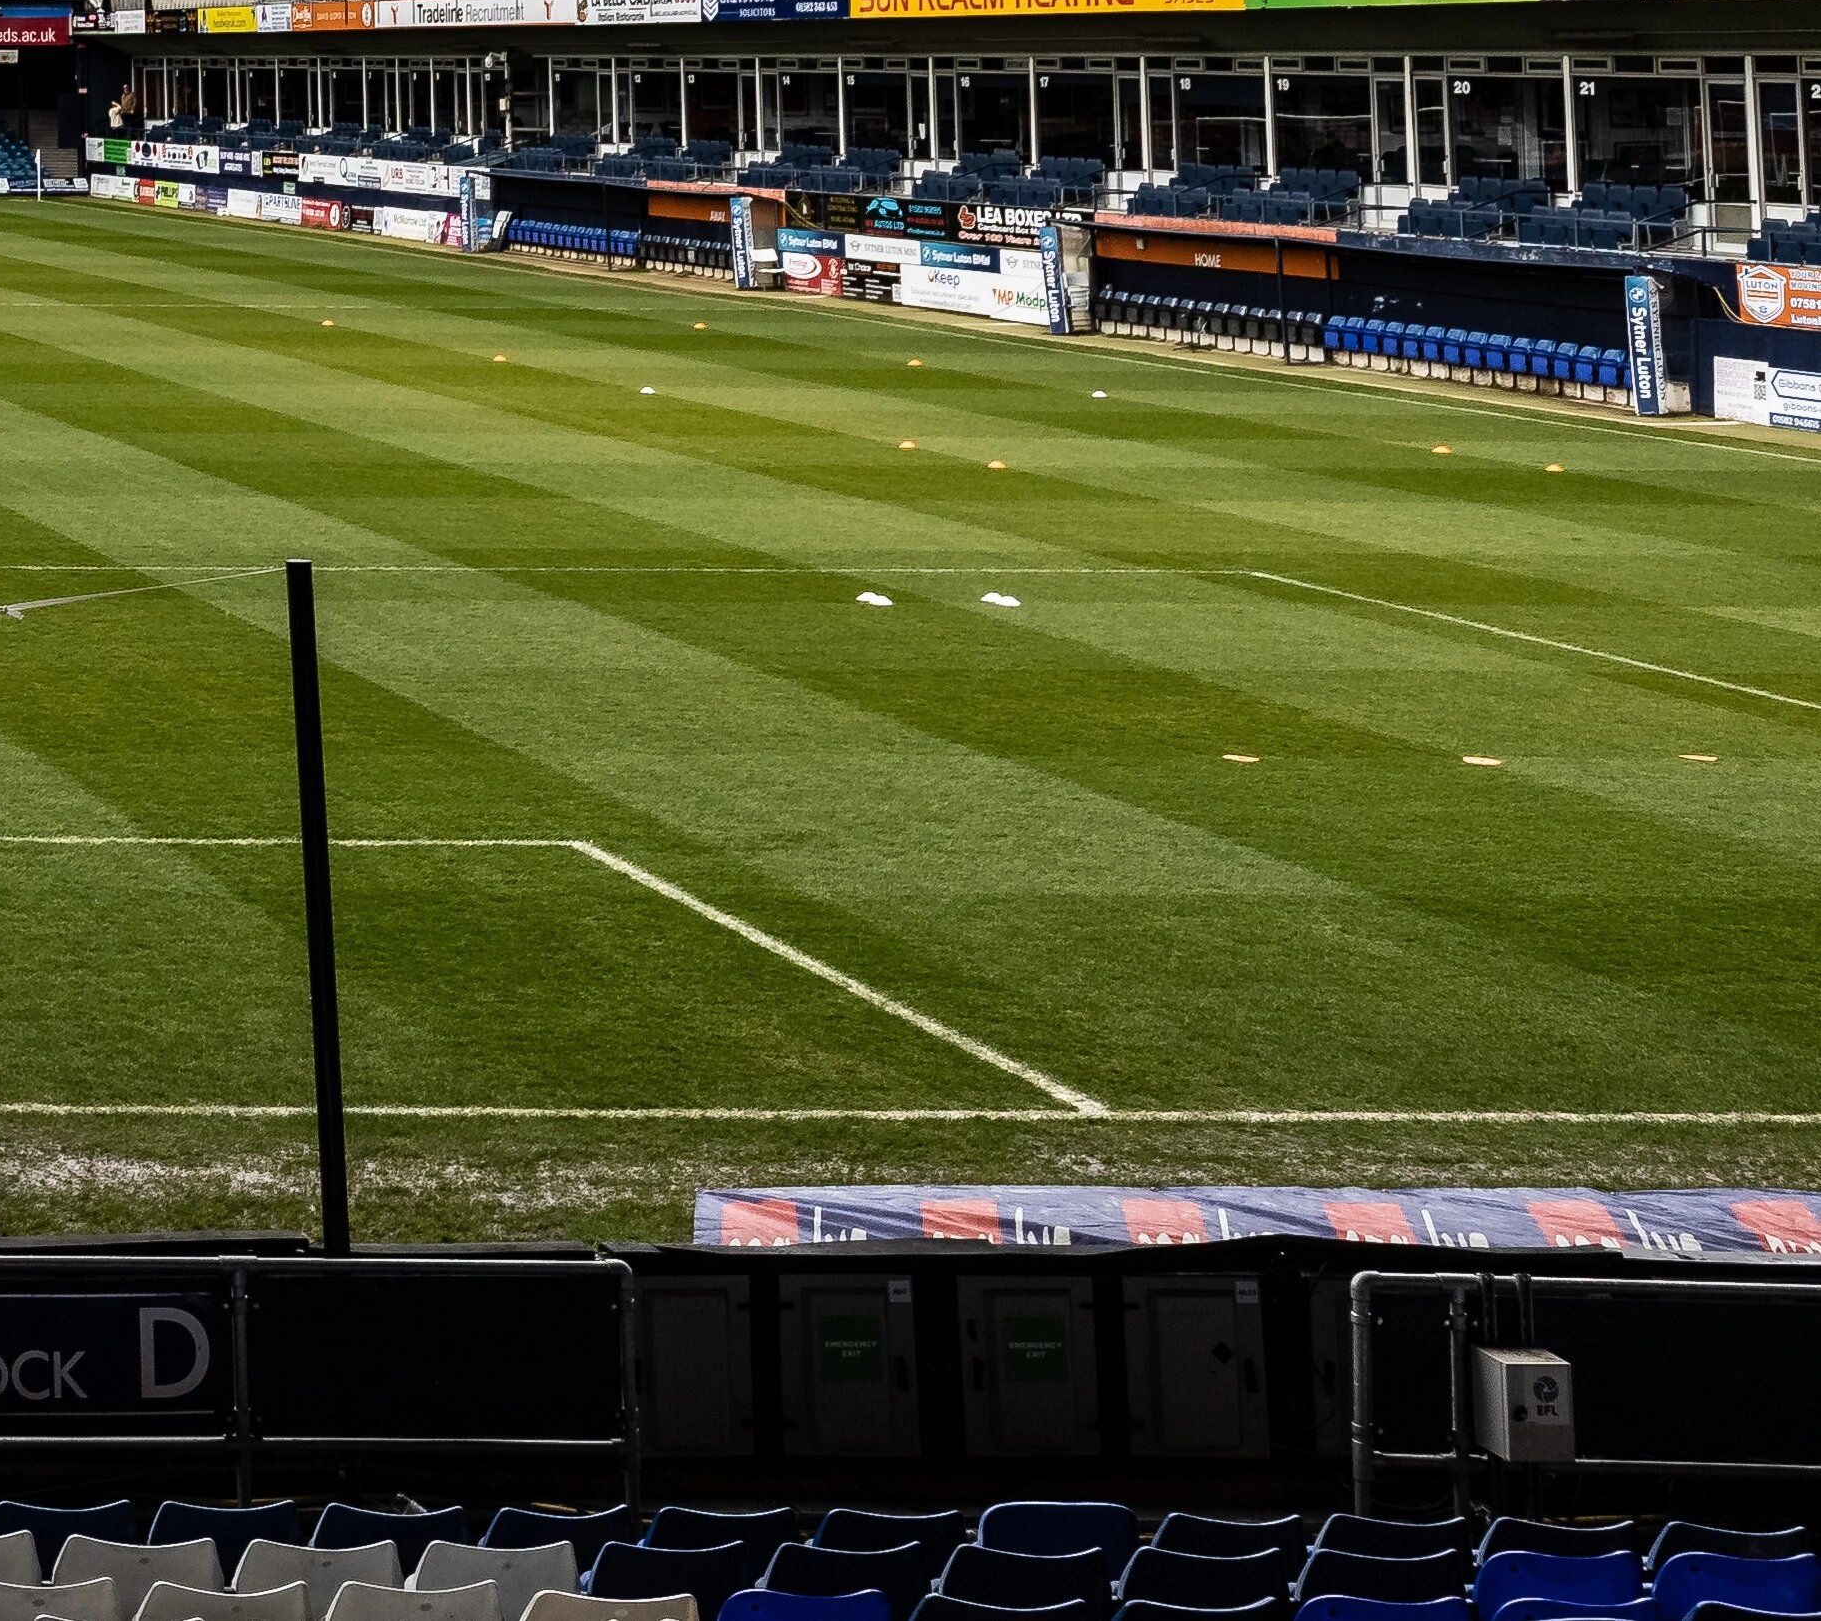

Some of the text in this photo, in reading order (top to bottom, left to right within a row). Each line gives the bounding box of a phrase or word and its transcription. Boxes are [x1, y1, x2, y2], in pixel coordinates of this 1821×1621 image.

[417, 1, 524, 24] Tradeline Recruitment
[739, 8, 775, 18] SOLICITORS
[1180, 79, 1191, 90] 18
[1277, 79, 1289, 90] 19
[1454, 81, 1471, 93] 20
[1580, 82, 1596, 95] 21
[977, 206, 1002, 224] LEA
[789, 235, 822, 248] Sytner Luton
[959, 231, 983, 241] Over
[732, 217, 746, 278] Sytner Luton
[932, 251, 972, 264] Sytner Luton
[1195, 253, 1221, 268] HOME
[1043, 251, 1060, 322] Sytner Luton
[1746, 280, 1778, 290] LUTON
[1630, 307, 1651, 398] Sytner Luton
[1779, 379, 1816, 392] Gibbons
[1773, 415, 1793, 426] 01582
[824, 1340, 878, 1349] EMERGENCY
[1009, 1341, 1062, 1350] EMERGENCY
[139, 1307, 210, 1399] D
[842, 1350, 861, 1358] EXIT
[1026, 1351, 1046, 1359] EXIT
[1537, 1404, 1559, 1417] EFL
